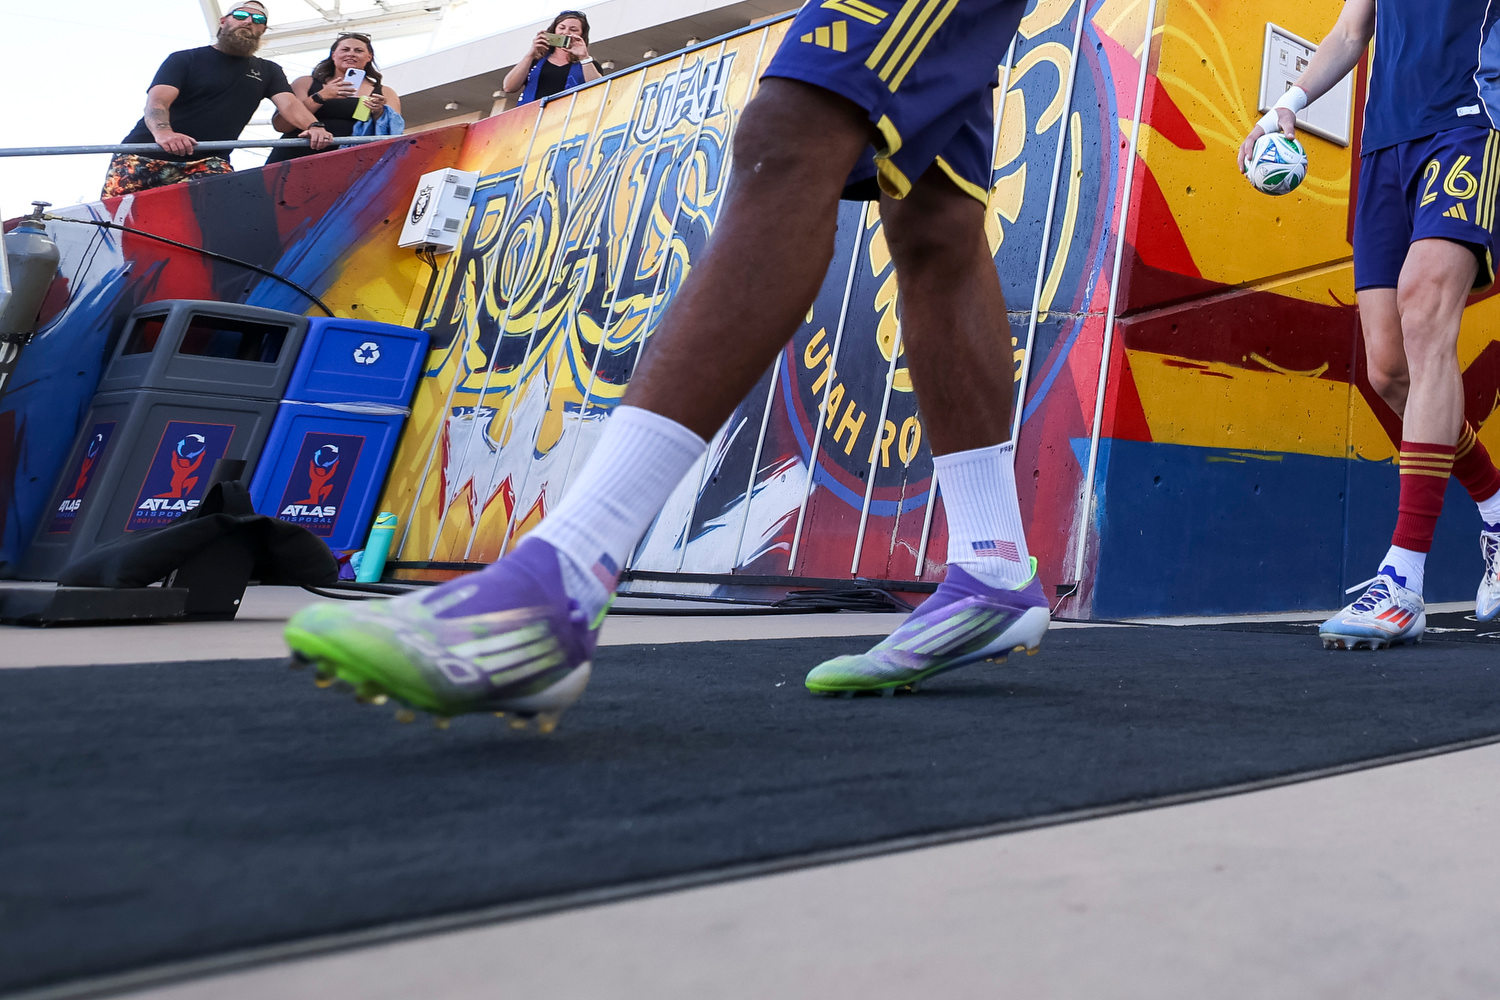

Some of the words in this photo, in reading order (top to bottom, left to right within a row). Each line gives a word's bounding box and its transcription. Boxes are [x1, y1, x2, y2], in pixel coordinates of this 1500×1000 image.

[634, 50, 739, 144] UTAH
[1420, 154, 1478, 208] 26
[803, 327, 867, 456] UTAH
[58, 499, 82, 513] ATLAS
[138, 498, 201, 513] ATLAS
[281, 504, 337, 518] ATLAS
